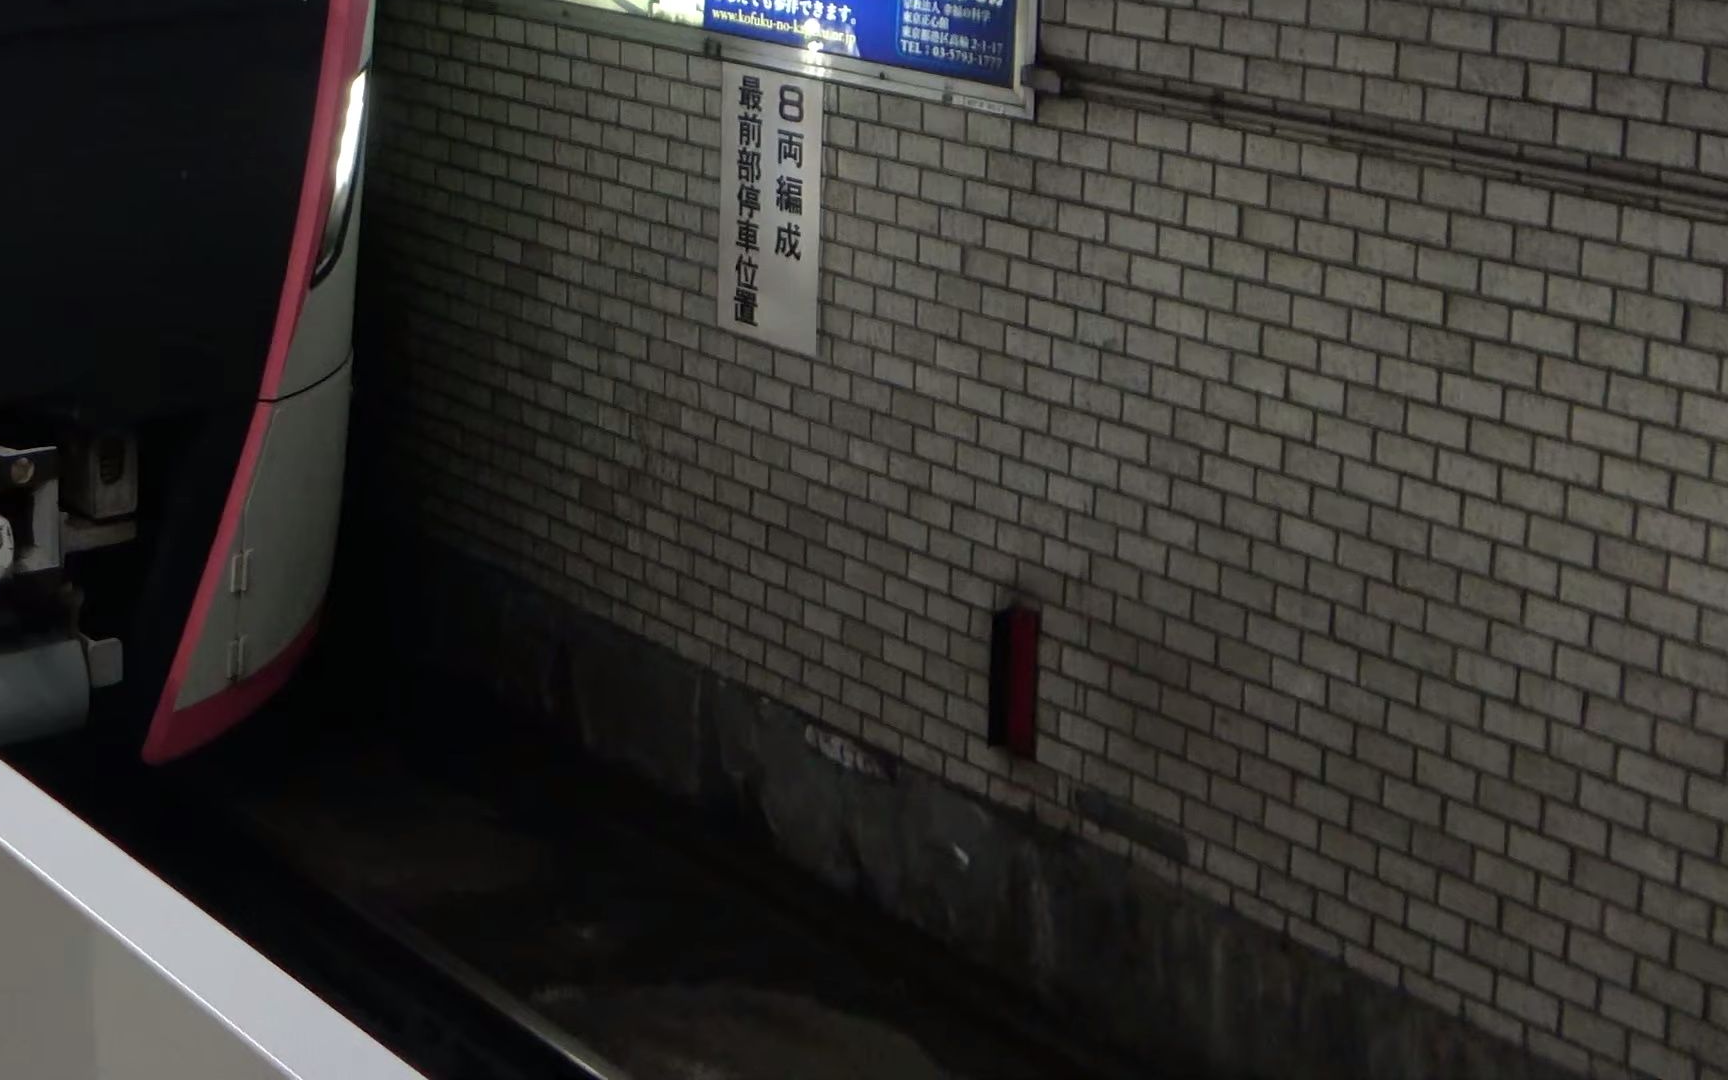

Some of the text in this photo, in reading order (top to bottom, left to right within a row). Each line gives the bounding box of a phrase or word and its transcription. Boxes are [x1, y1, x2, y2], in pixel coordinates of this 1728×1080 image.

[733, 74, 764, 327] 最前部停車位置
[775, 84, 804, 261] 8両編成
